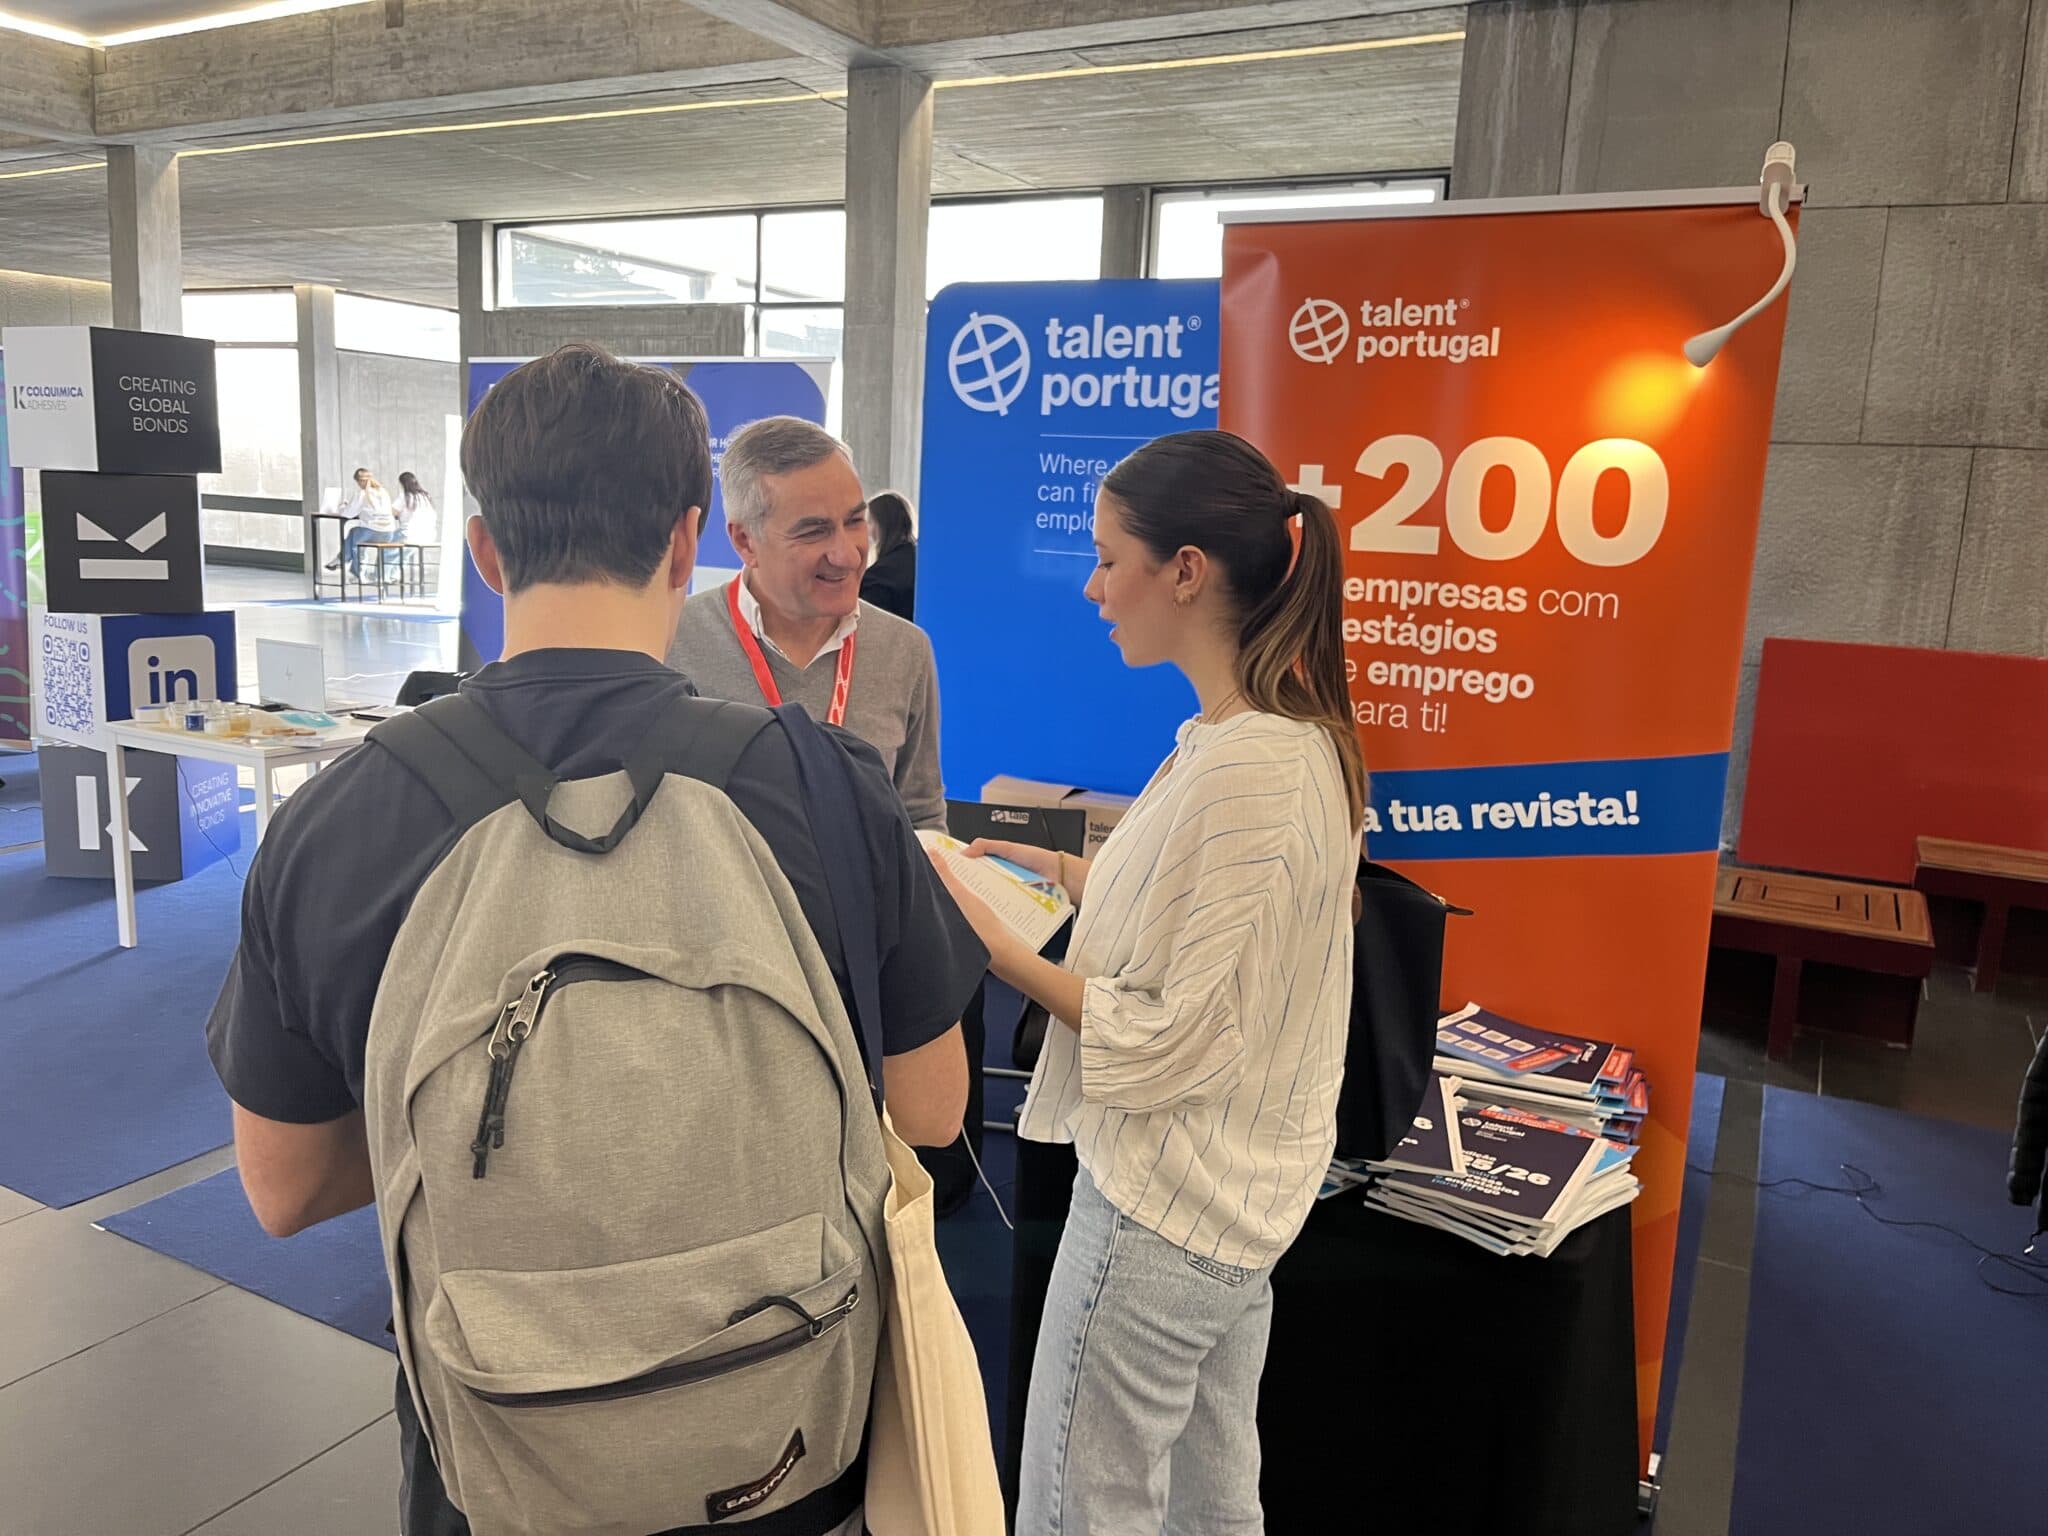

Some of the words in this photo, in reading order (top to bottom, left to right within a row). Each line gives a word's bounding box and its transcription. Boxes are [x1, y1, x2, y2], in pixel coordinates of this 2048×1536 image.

[1356, 327, 1501, 364] portugal
[26, 386, 84, 398] COLQUIMICA
[119, 375, 197, 396] CREATING
[1040, 366, 1220, 418] portuga
[128, 396, 191, 415] GLOBAL
[132, 416, 189, 434] BONDS
[1039, 453, 1108, 476] Where
[1037, 484, 1075, 502] can
[1082, 482, 1096, 503] fi
[1286, 434, 1670, 567] +200
[1343, 577, 1528, 614] empresas
[1538, 589, 1620, 619] com
[43, 615, 75, 634] FOLLOW
[76, 621, 88, 634] US
[1342, 614, 1498, 656] estágios
[147, 655, 198, 704] in
[1367, 658, 1535, 704] emprego
[1351, 700, 1409, 729] ara
[1420, 702, 1448, 733] ti!
[192, 772, 229, 798] CREATING
[1388, 799, 1462, 832] tua
[1470, 790, 1641, 829] revista!
